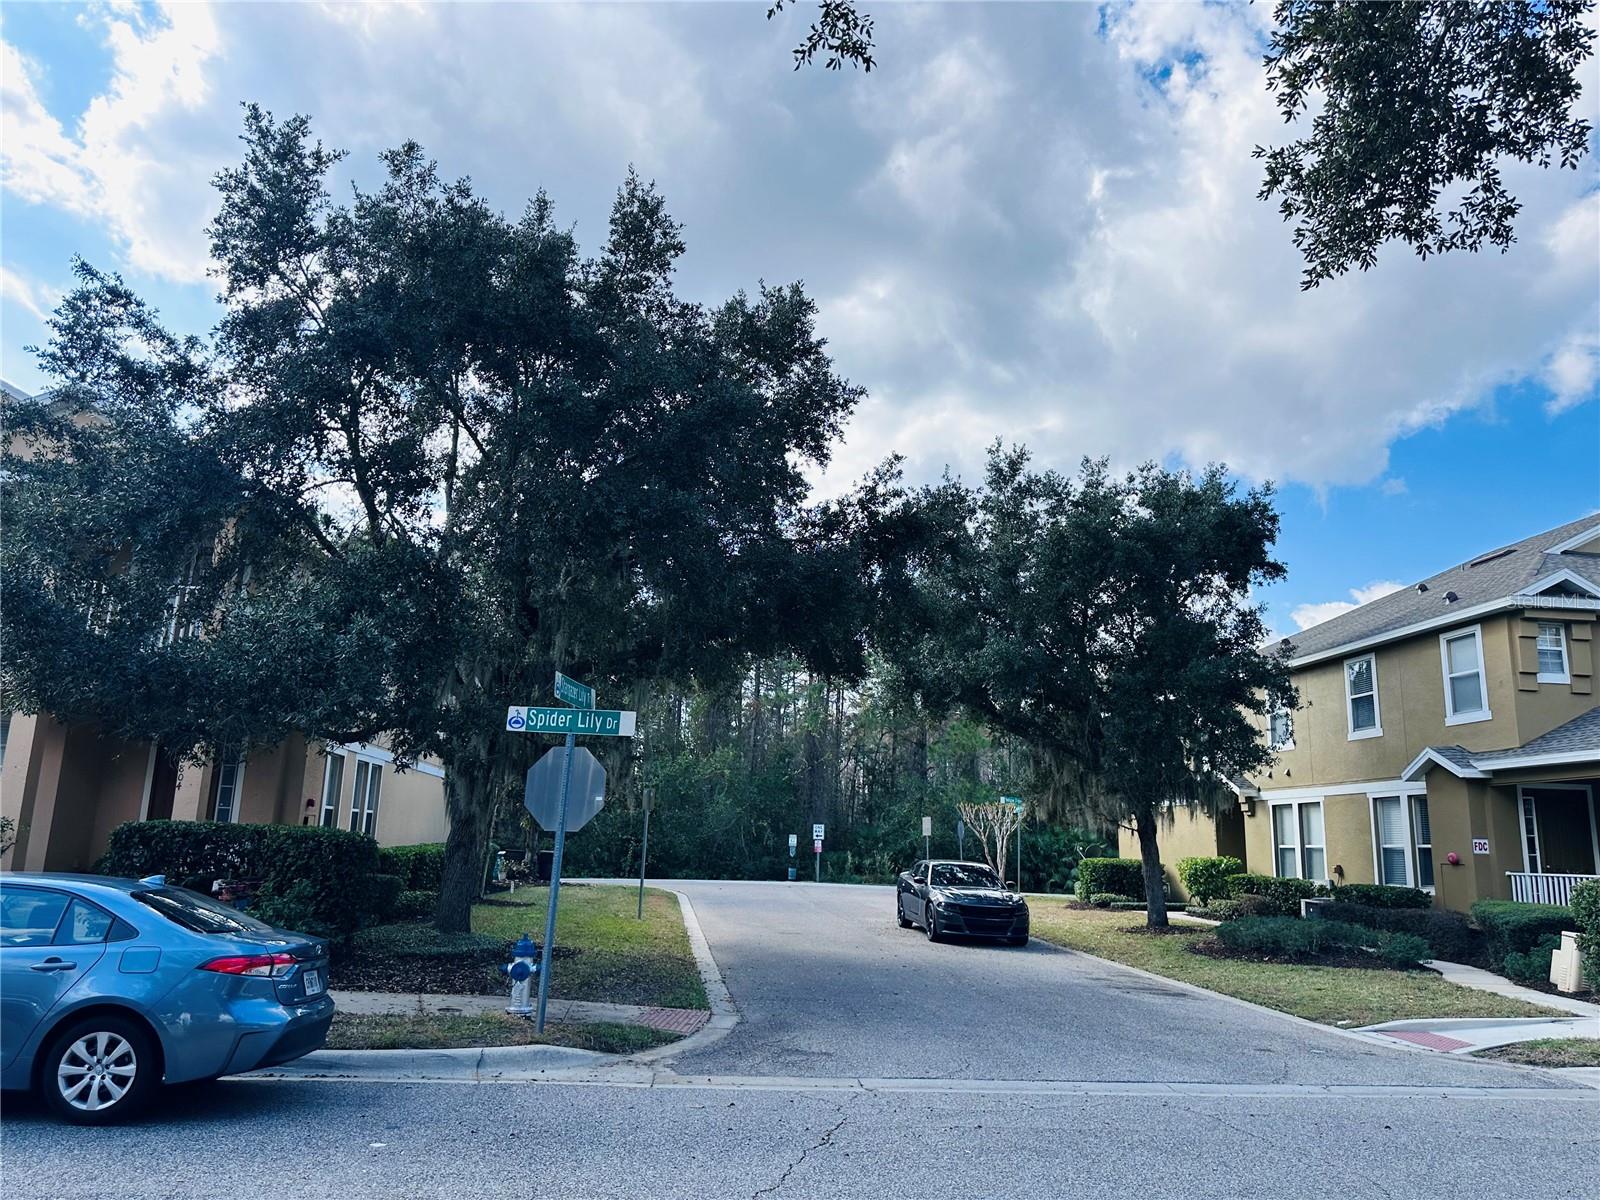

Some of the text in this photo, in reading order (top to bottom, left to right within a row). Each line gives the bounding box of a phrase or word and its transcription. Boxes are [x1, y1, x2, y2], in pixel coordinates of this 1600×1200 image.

[528, 709, 618, 732] Spider Lily Dr
[1474, 841, 1488, 852] FDC
